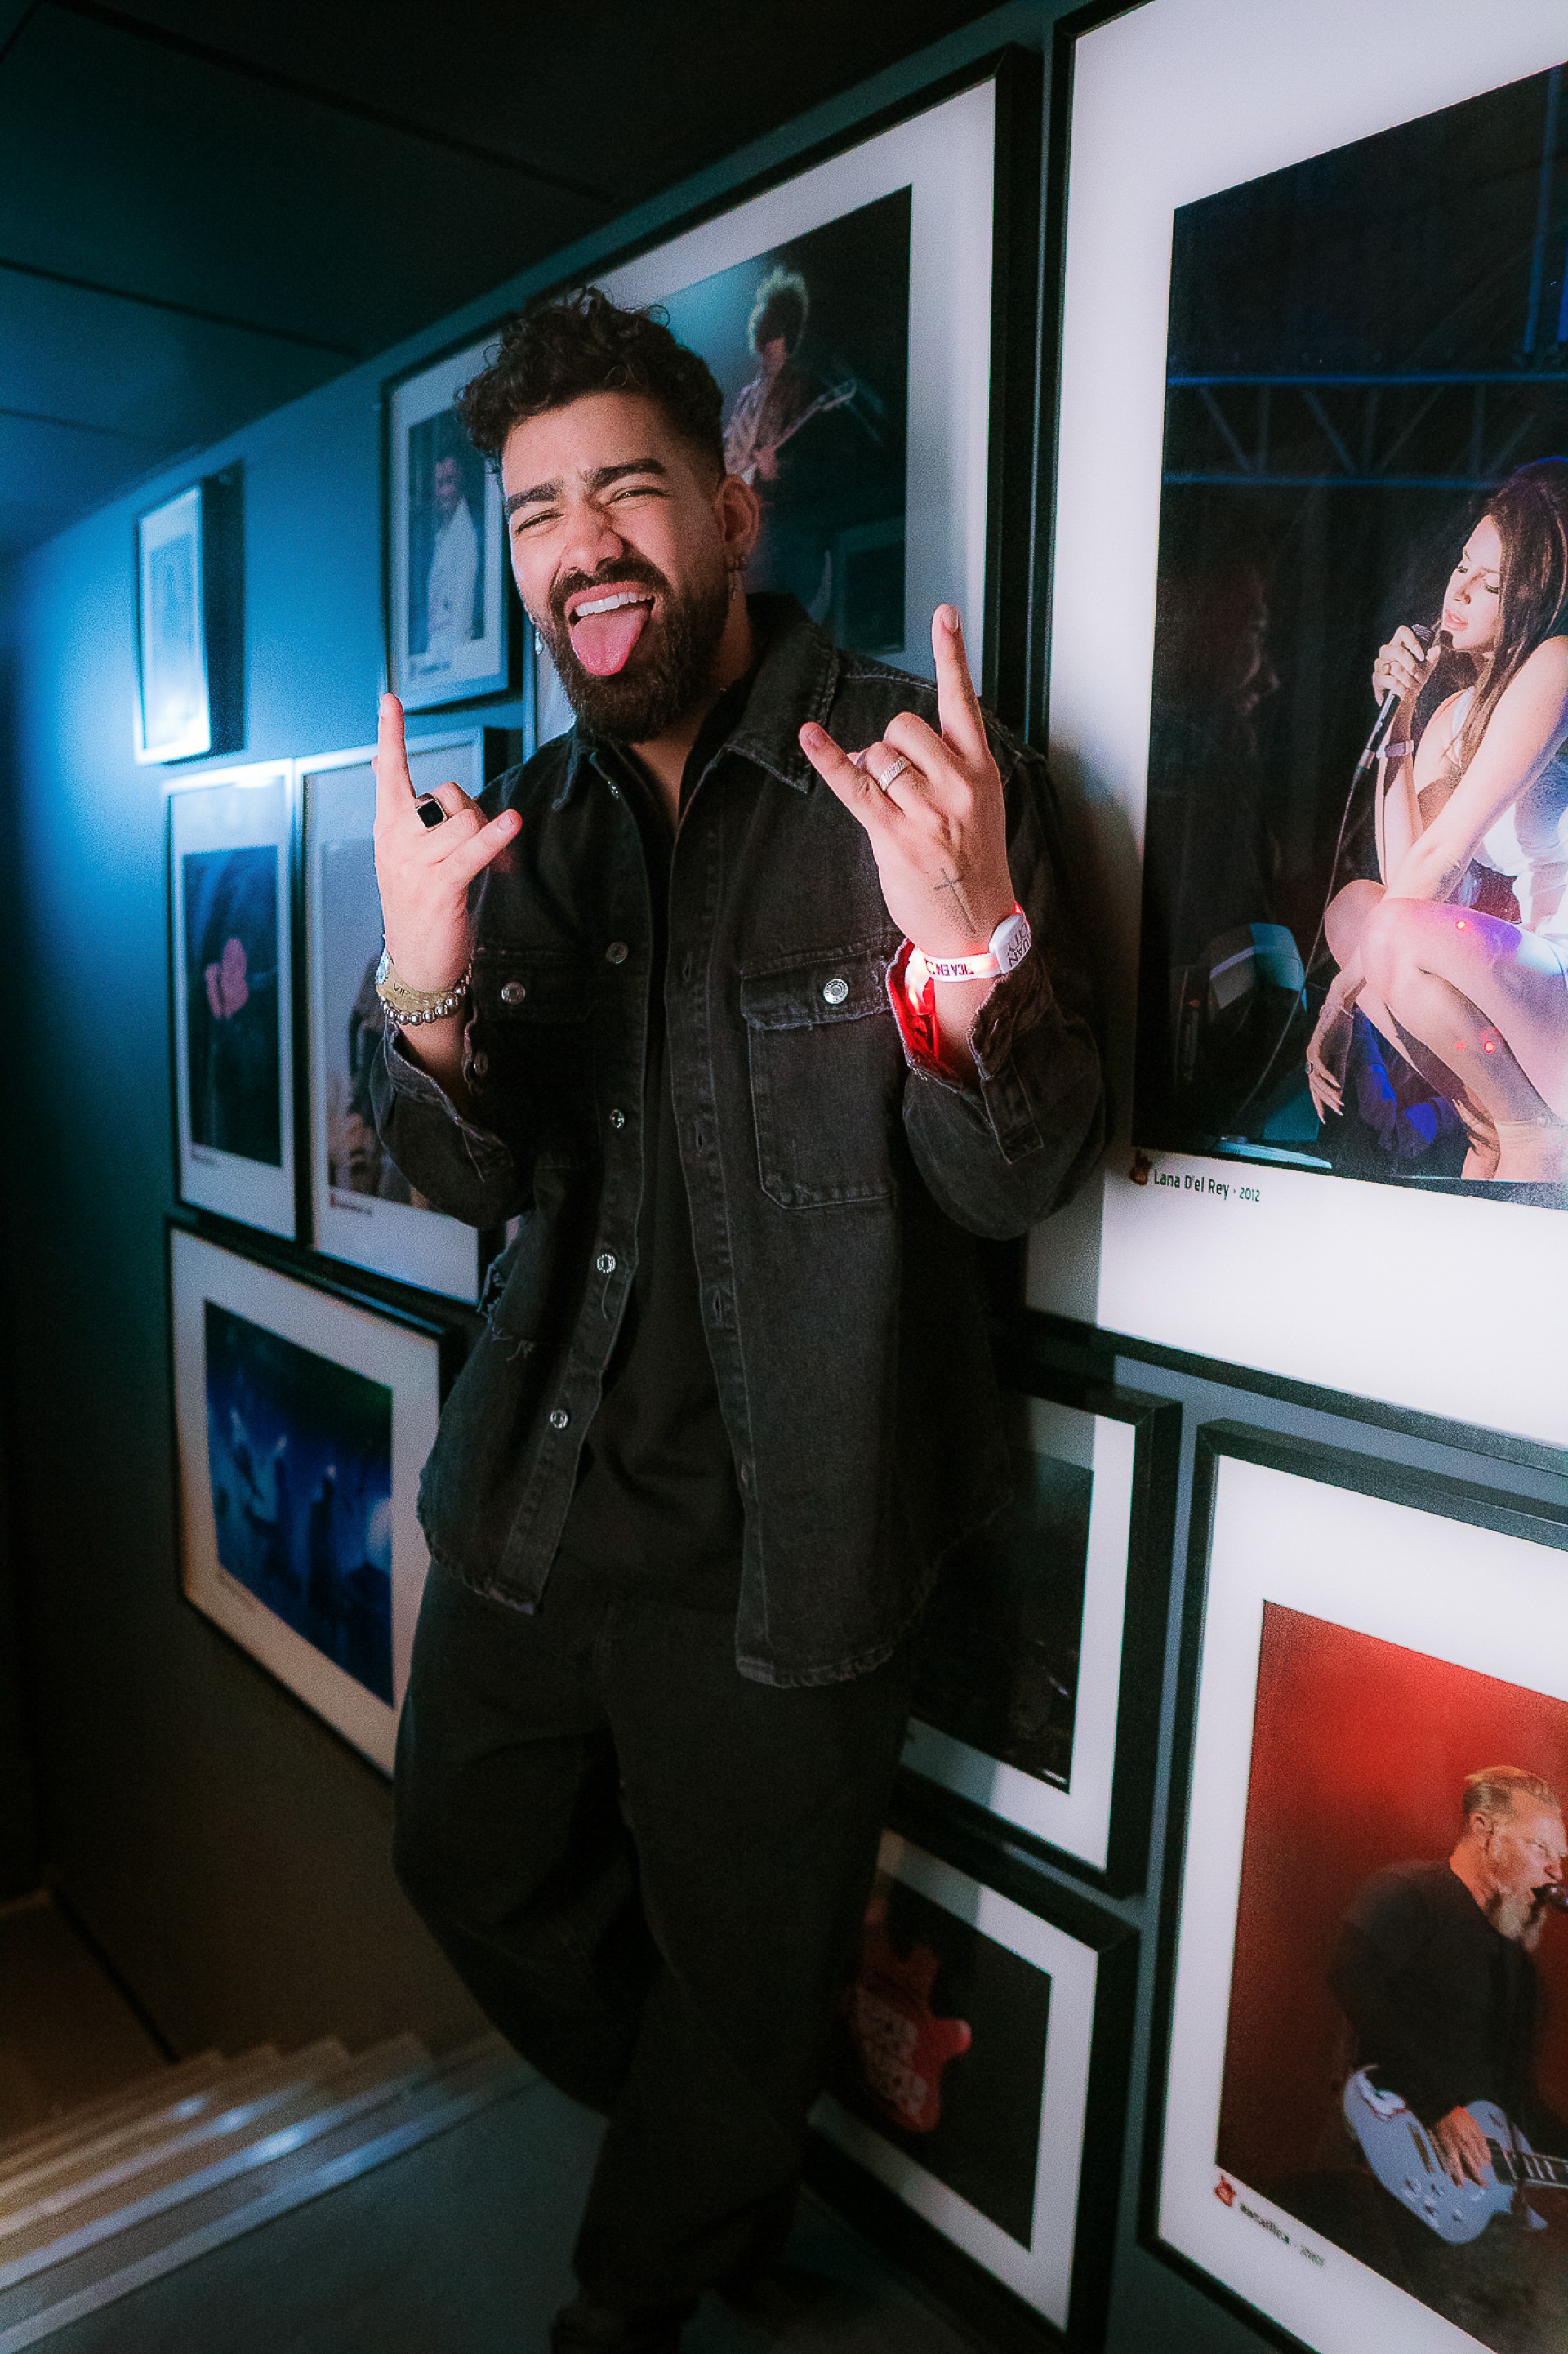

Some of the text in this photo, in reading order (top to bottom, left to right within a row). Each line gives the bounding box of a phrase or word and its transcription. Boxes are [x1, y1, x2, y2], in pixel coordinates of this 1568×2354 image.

[935, 963, 950, 977] EM
[1154, 1169, 1181, 1188] Lana
[1208, 1179, 1230, 1201] Rey
[1239, 1187, 1261, 1202] 2012
